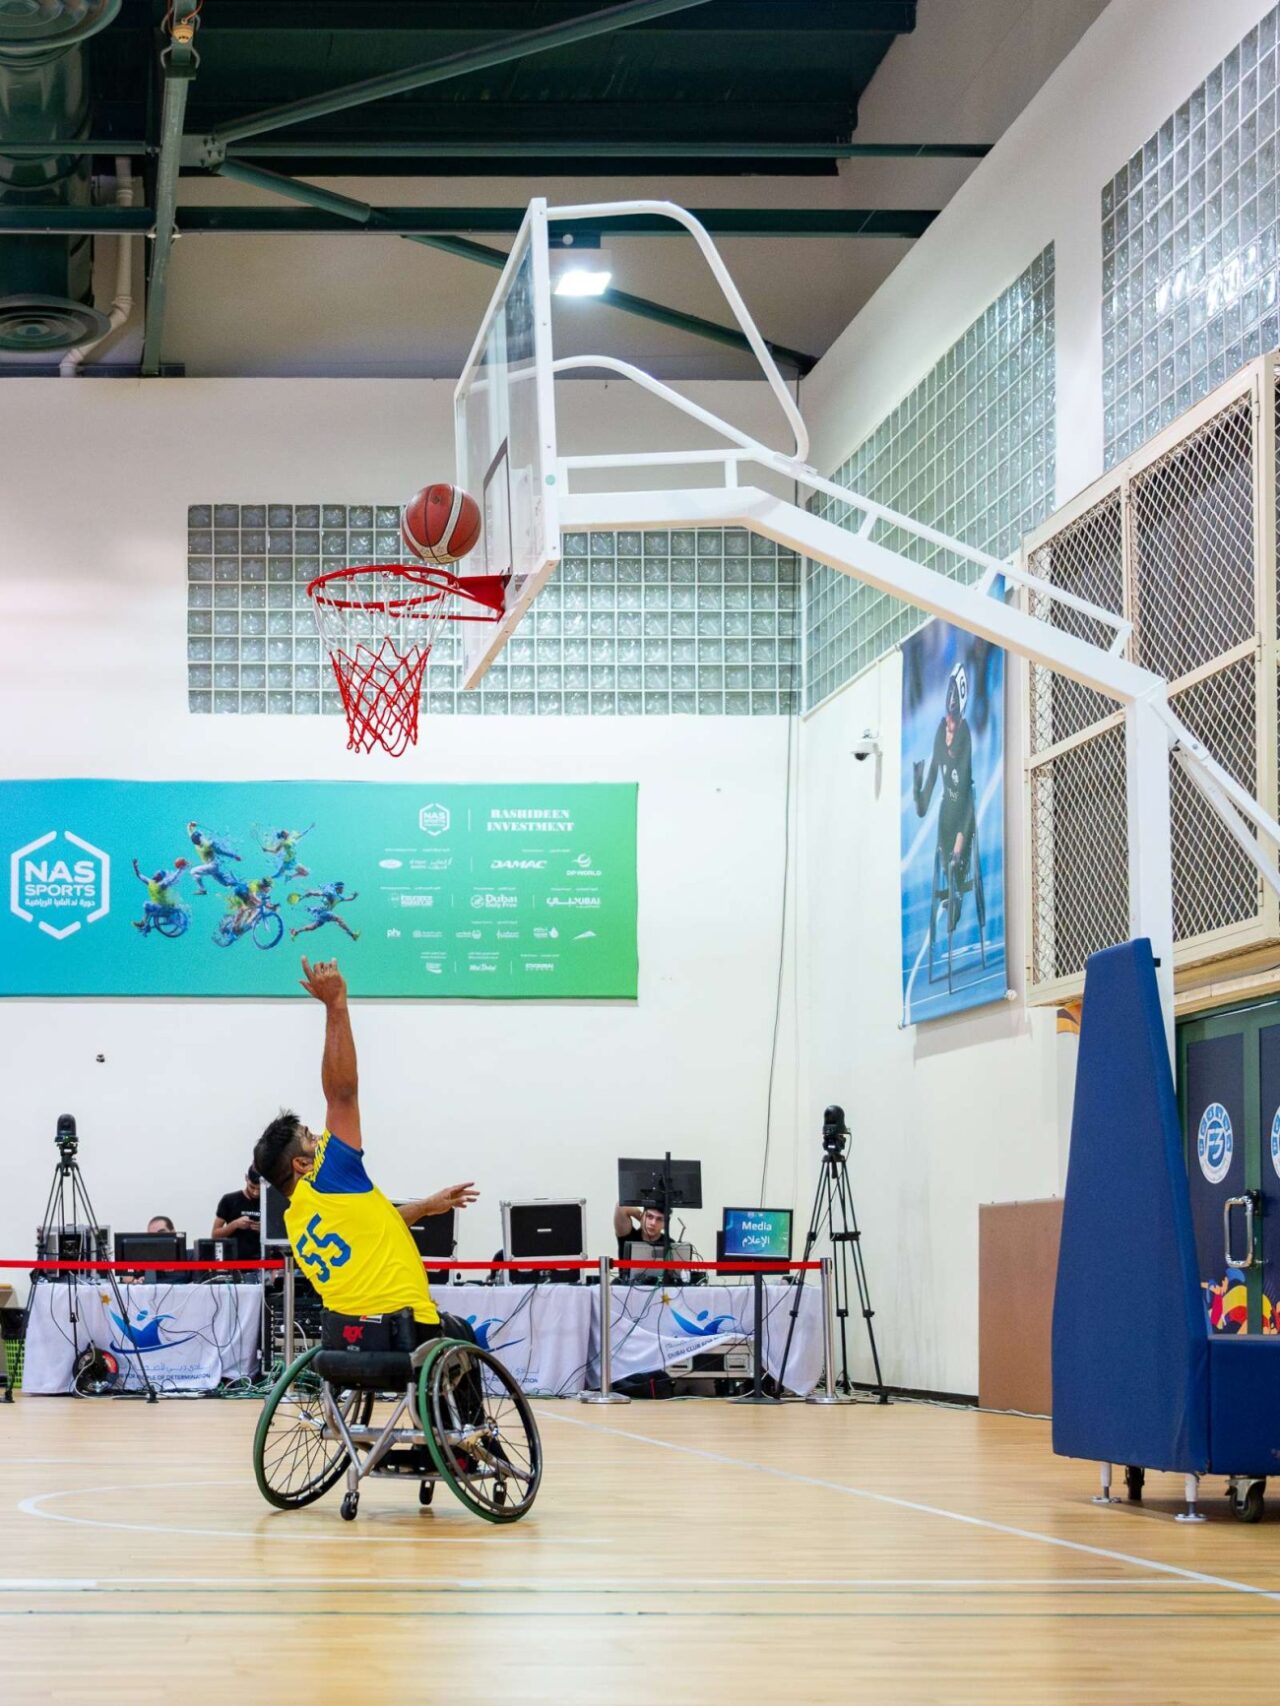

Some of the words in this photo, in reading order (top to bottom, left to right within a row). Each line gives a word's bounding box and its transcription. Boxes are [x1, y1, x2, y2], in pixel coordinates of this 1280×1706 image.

[424, 812, 445, 820] NAS
[490, 809, 570, 819] RASHIDEEN
[486, 821, 575, 831] INVESTMENT
[490, 860, 547, 869] DAMAC
[25, 860, 96, 883] NAS
[25, 884, 96, 896] SPORTS
[485, 895, 517, 904] Dubai
[742, 1221, 772, 1231] Media
[296, 1213, 351, 1283] 55
[167, 1373, 211, 1381] DETERMINATION
